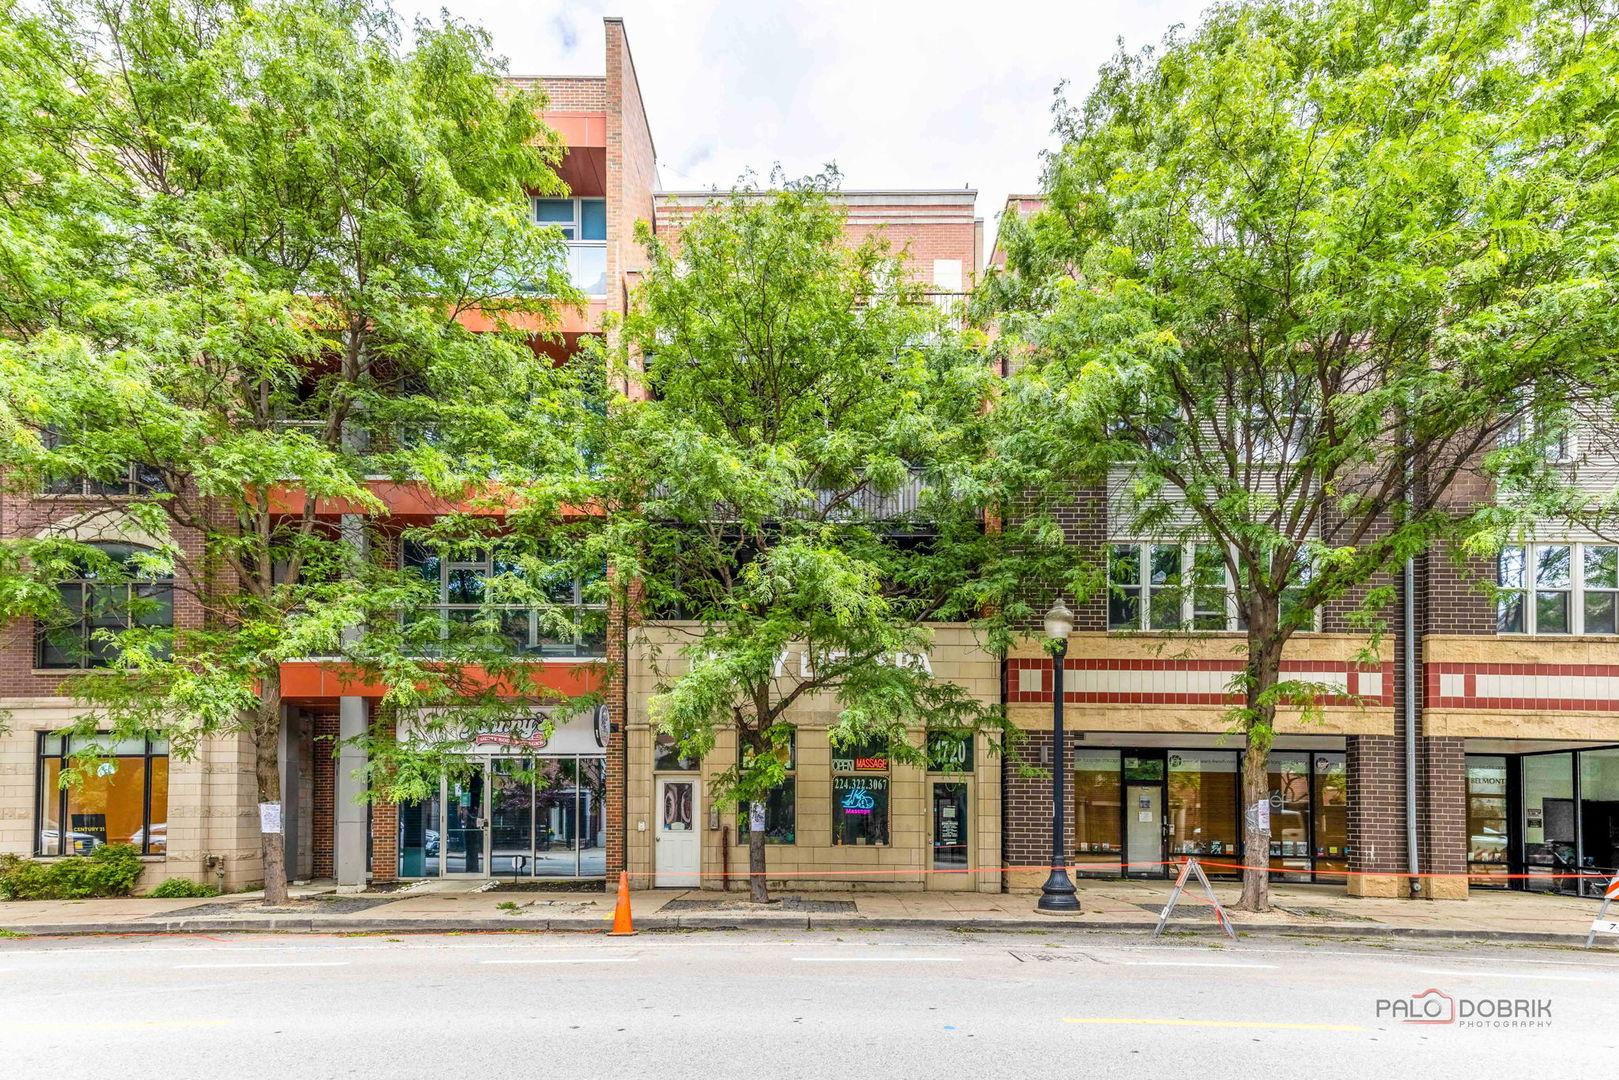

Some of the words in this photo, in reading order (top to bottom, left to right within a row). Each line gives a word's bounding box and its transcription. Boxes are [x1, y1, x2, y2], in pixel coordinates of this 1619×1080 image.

[832, 760, 854, 771] OPEN
[856, 758, 887, 768] MASSAGE
[834, 778, 887, 790] 224.322.3067
[1470, 777, 1505, 785] BELMONT
